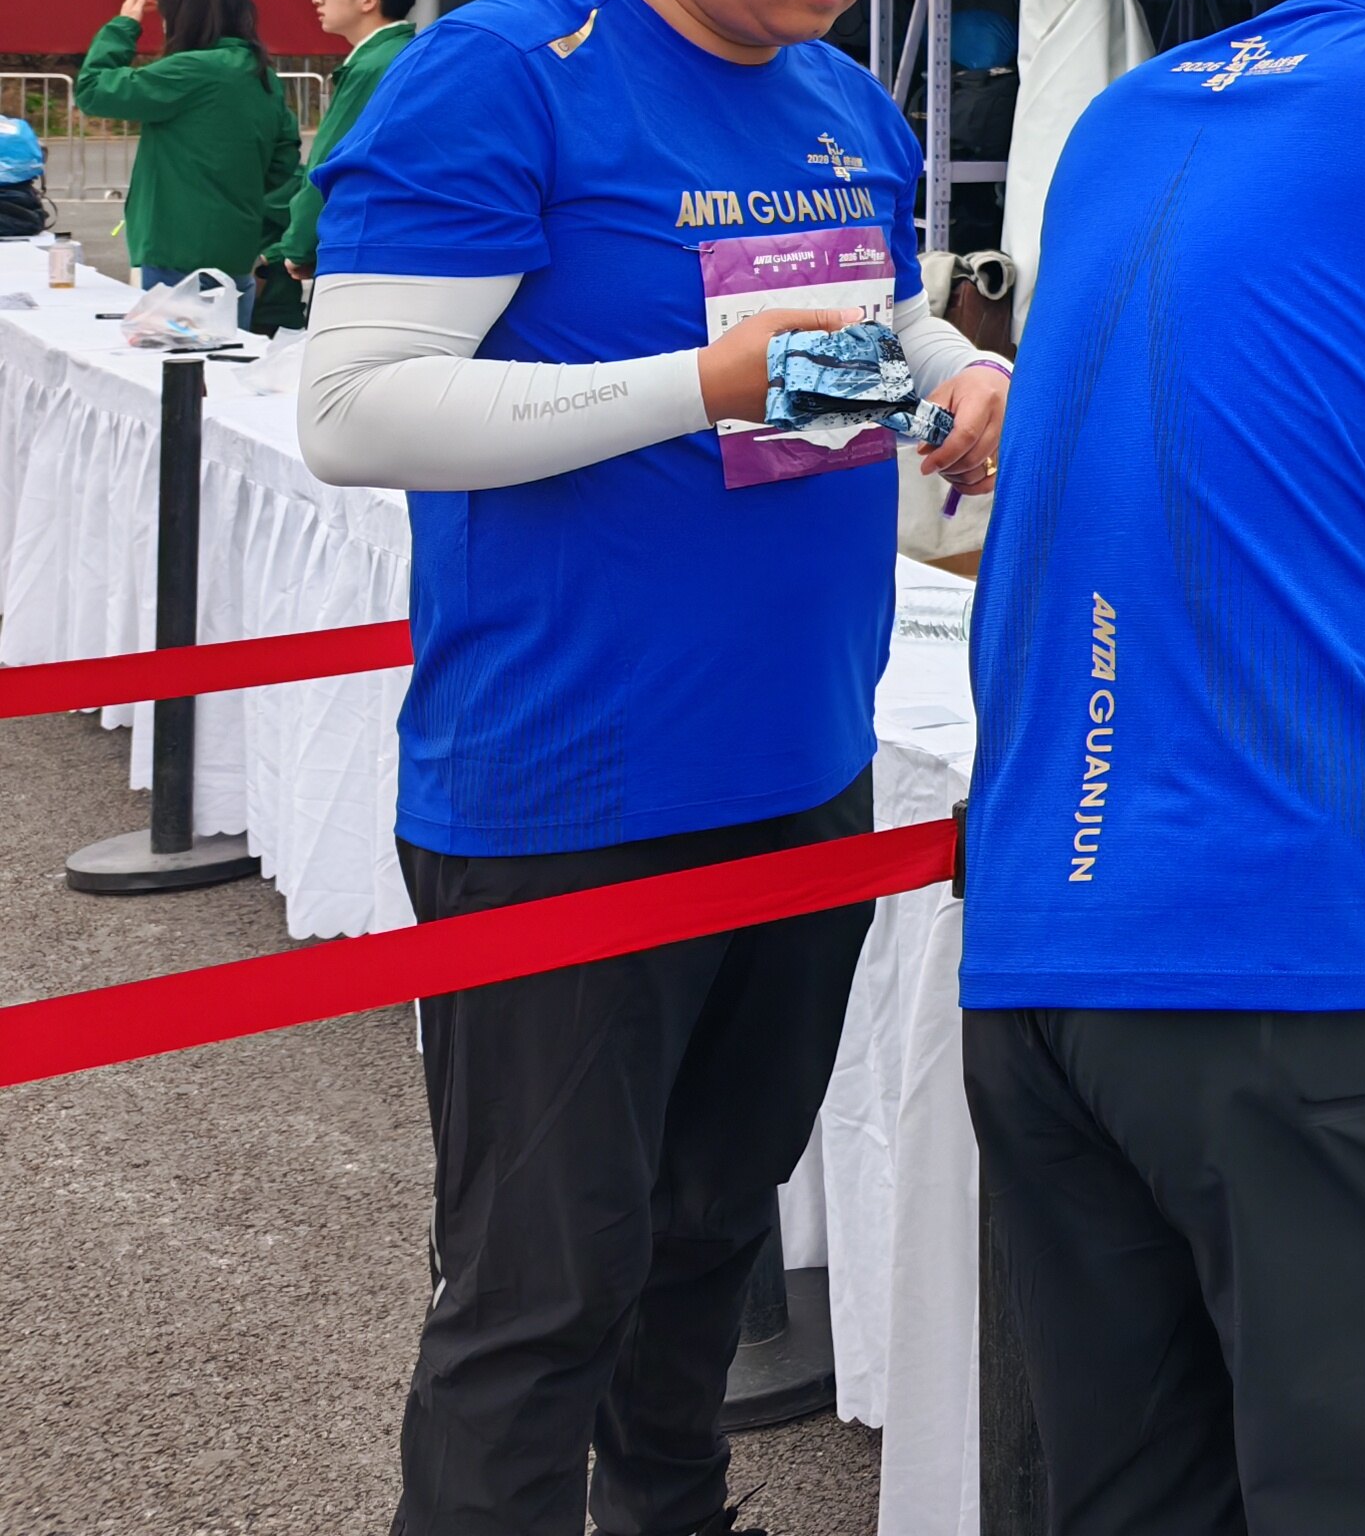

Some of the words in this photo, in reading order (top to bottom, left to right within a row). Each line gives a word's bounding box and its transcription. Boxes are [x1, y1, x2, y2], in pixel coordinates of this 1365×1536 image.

[675, 189, 744, 229] ANTA
[747, 187, 876, 225] GUANJUN
[512, 380, 629, 423] MIAOCHEN
[1090, 590, 1116, 682] ANTA
[1068, 688, 1115, 882] GUANJUN
